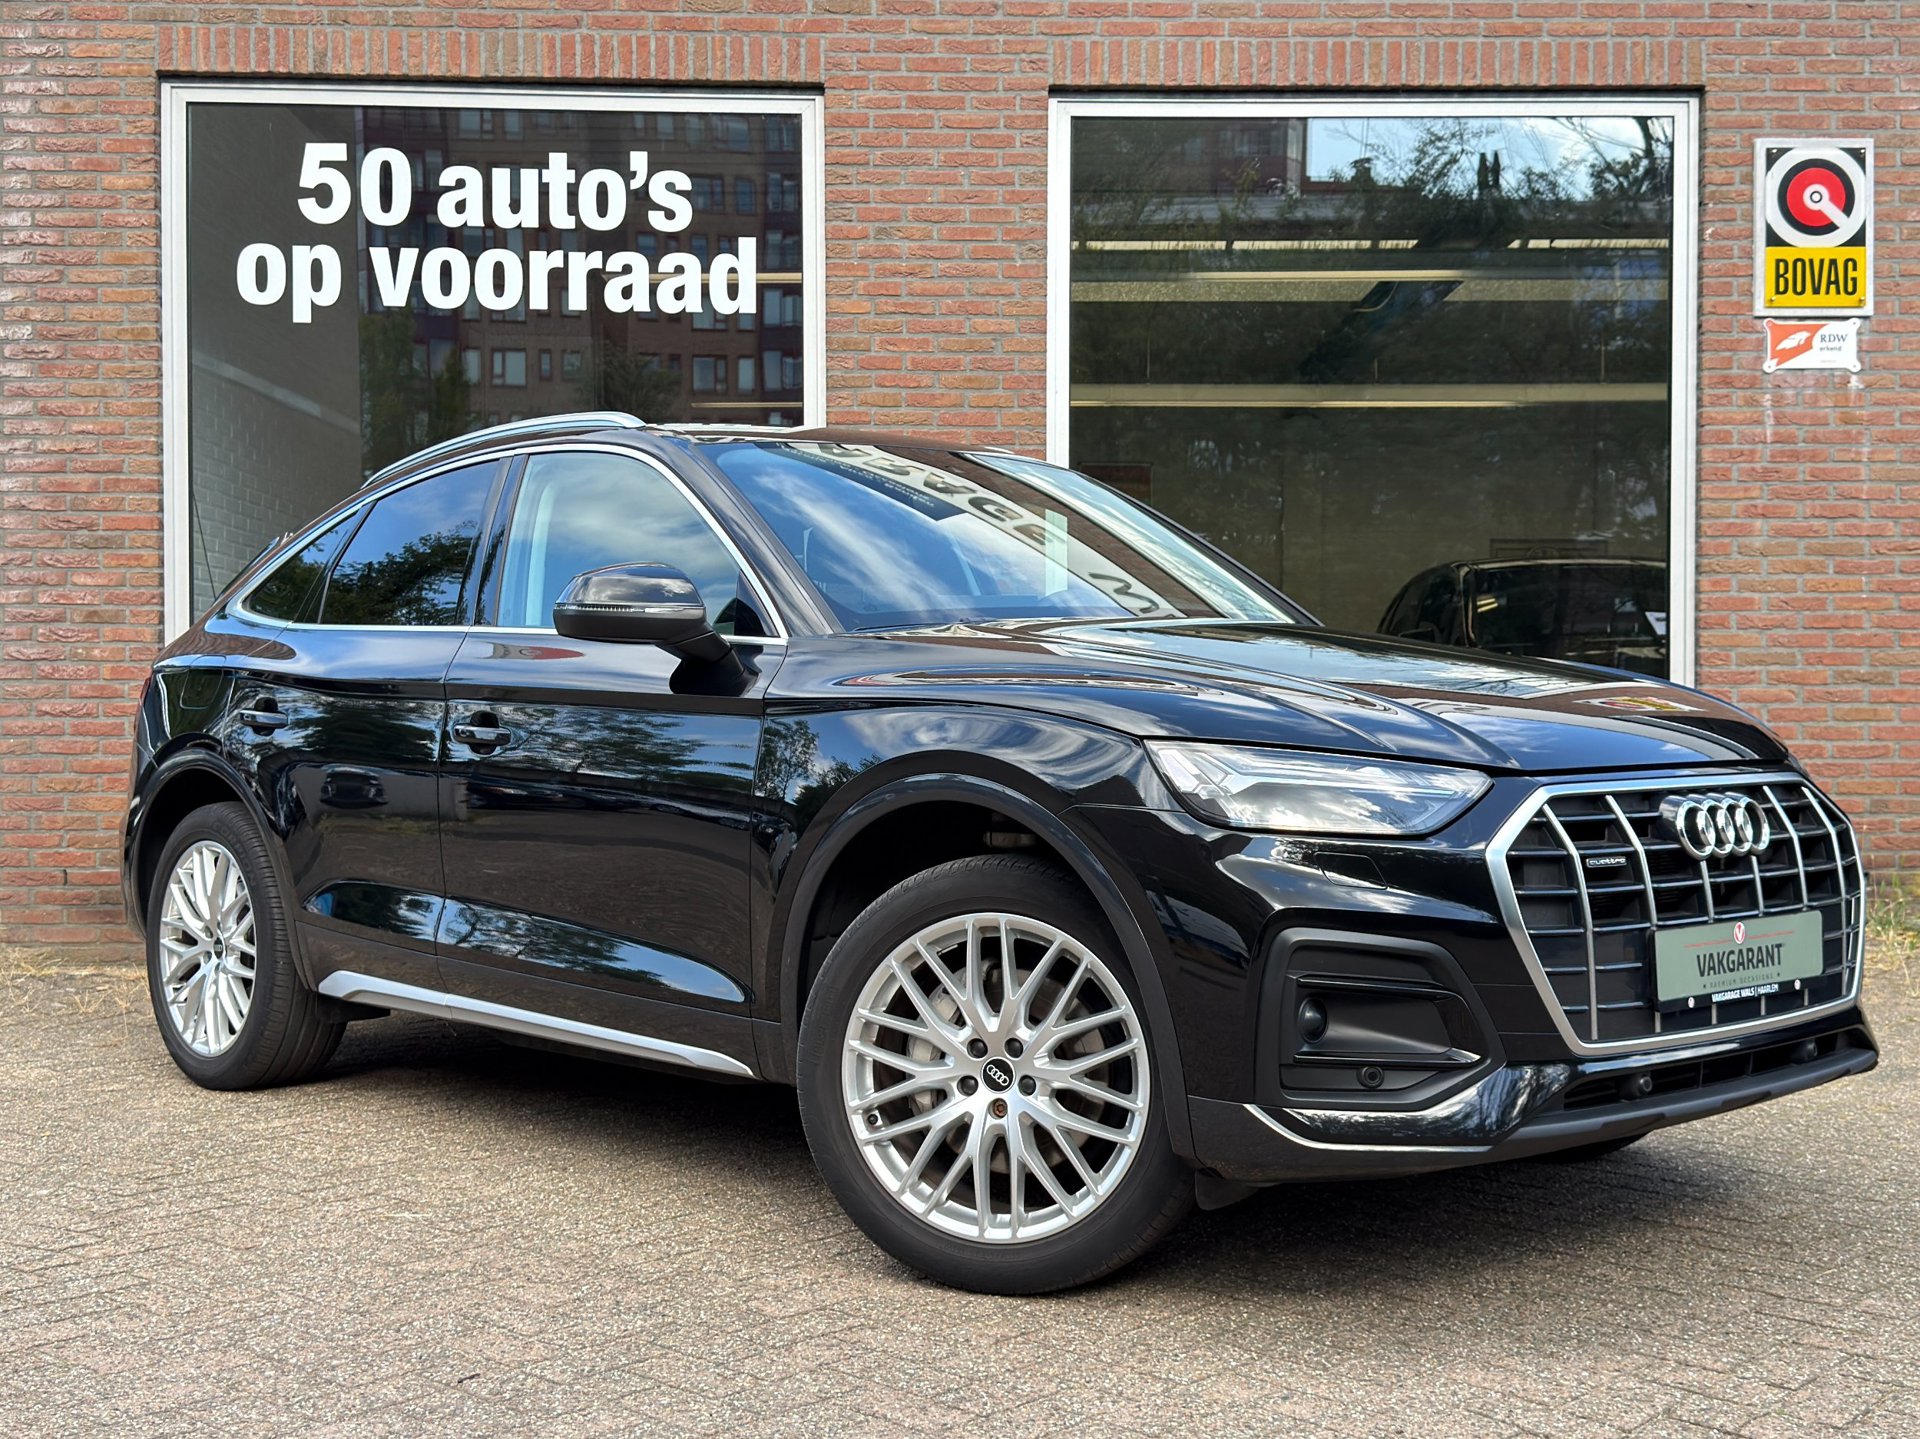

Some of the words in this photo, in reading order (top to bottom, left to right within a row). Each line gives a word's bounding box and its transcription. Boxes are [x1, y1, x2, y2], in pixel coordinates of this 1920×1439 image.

[298, 142, 413, 226] 50
[437, 150, 693, 233] auto's
[236, 243, 342, 323] op
[368, 237, 757, 314] voorraad
[1774, 257, 1858, 296] BOVAG
[1820, 333, 1848, 343] RDW
[1696, 943, 1784, 977] VAKGARANT
